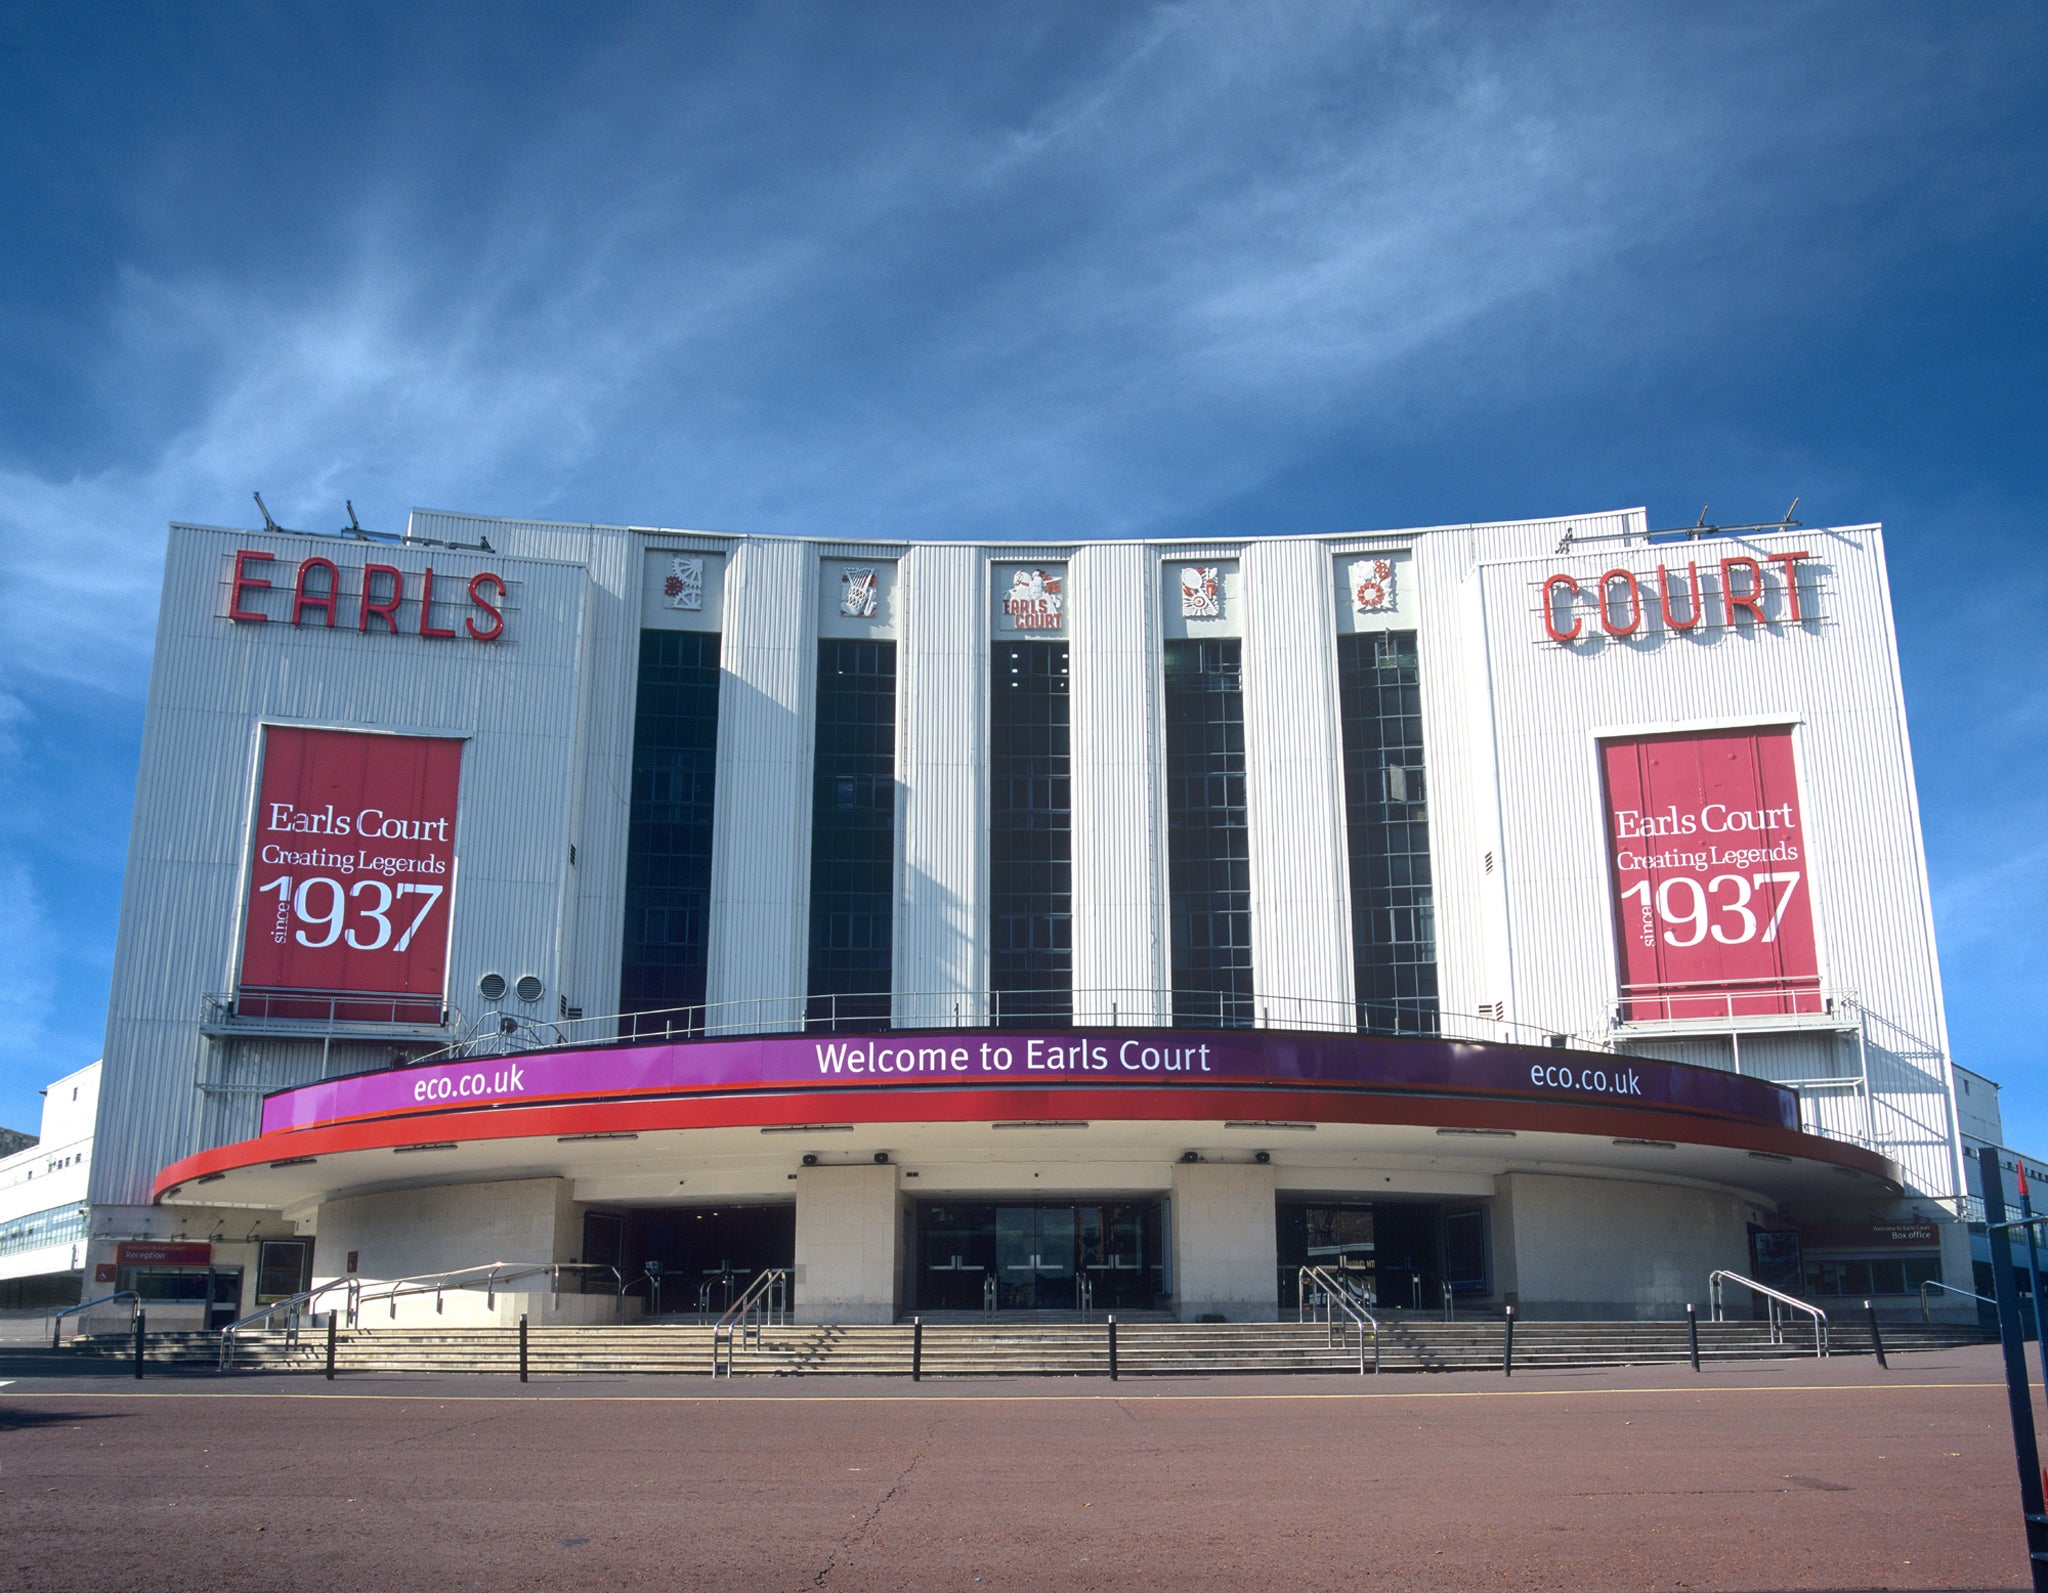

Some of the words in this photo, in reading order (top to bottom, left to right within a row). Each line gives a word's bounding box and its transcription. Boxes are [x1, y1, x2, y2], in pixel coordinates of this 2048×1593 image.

[229, 549, 507, 642] EARLS
[1002, 598, 1048, 615] EARLS
[1542, 550, 1810, 642] COURT
[1014, 611, 1063, 629] COURT
[267, 802, 351, 836] Earls
[356, 809, 449, 842] Court
[1615, 805, 1697, 839] Earls
[1700, 802, 1796, 833] Court
[261, 844, 355, 875] Creating
[357, 850, 446, 877] Legends
[1617, 848, 1708, 872] Creating
[1709, 841, 1799, 869] Legends
[259, 875, 444, 952] 1937
[270, 901, 290, 944] since
[1621, 871, 1801, 948] 1937
[1639, 904, 1655, 948] since
[815, 1041, 969, 1074] Welcome
[980, 1043, 1013, 1071] to
[1027, 1038, 1108, 1070] Earls
[1119, 1039, 1211, 1072] Court
[414, 1063, 525, 1101] eco.co.uk
[1530, 1064, 1642, 1095] eco.co.uk
[1891, 1231, 1907, 1239] Box
[1907, 1231, 1932, 1239] office
[125, 1250, 166, 1260] Reception
